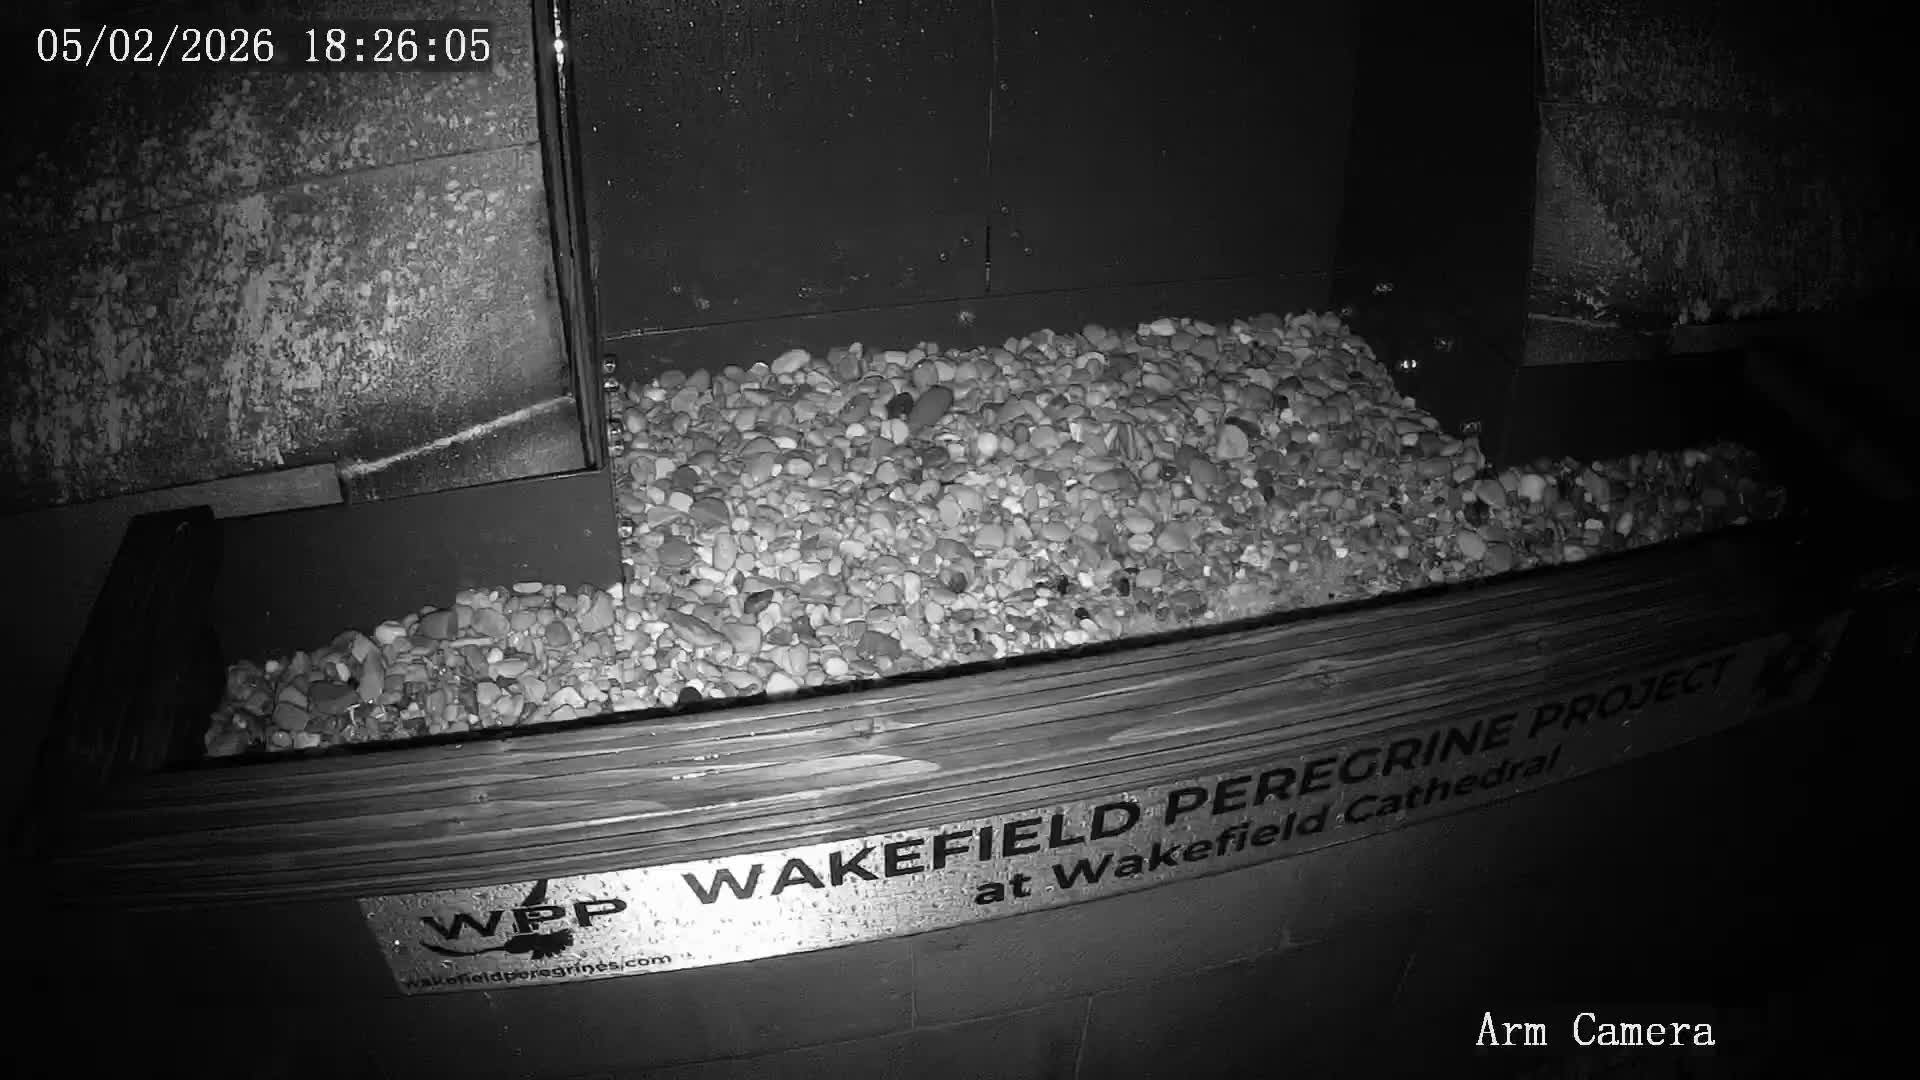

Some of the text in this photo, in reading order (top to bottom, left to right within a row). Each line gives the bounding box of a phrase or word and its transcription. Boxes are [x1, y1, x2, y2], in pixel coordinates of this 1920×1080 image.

[683, 653, 1738, 905] WAKEFIELD PEREGRINE PROJECT
[974, 744, 1562, 905] at Wakefield Cathedral
[421, 898, 628, 940] WPP
